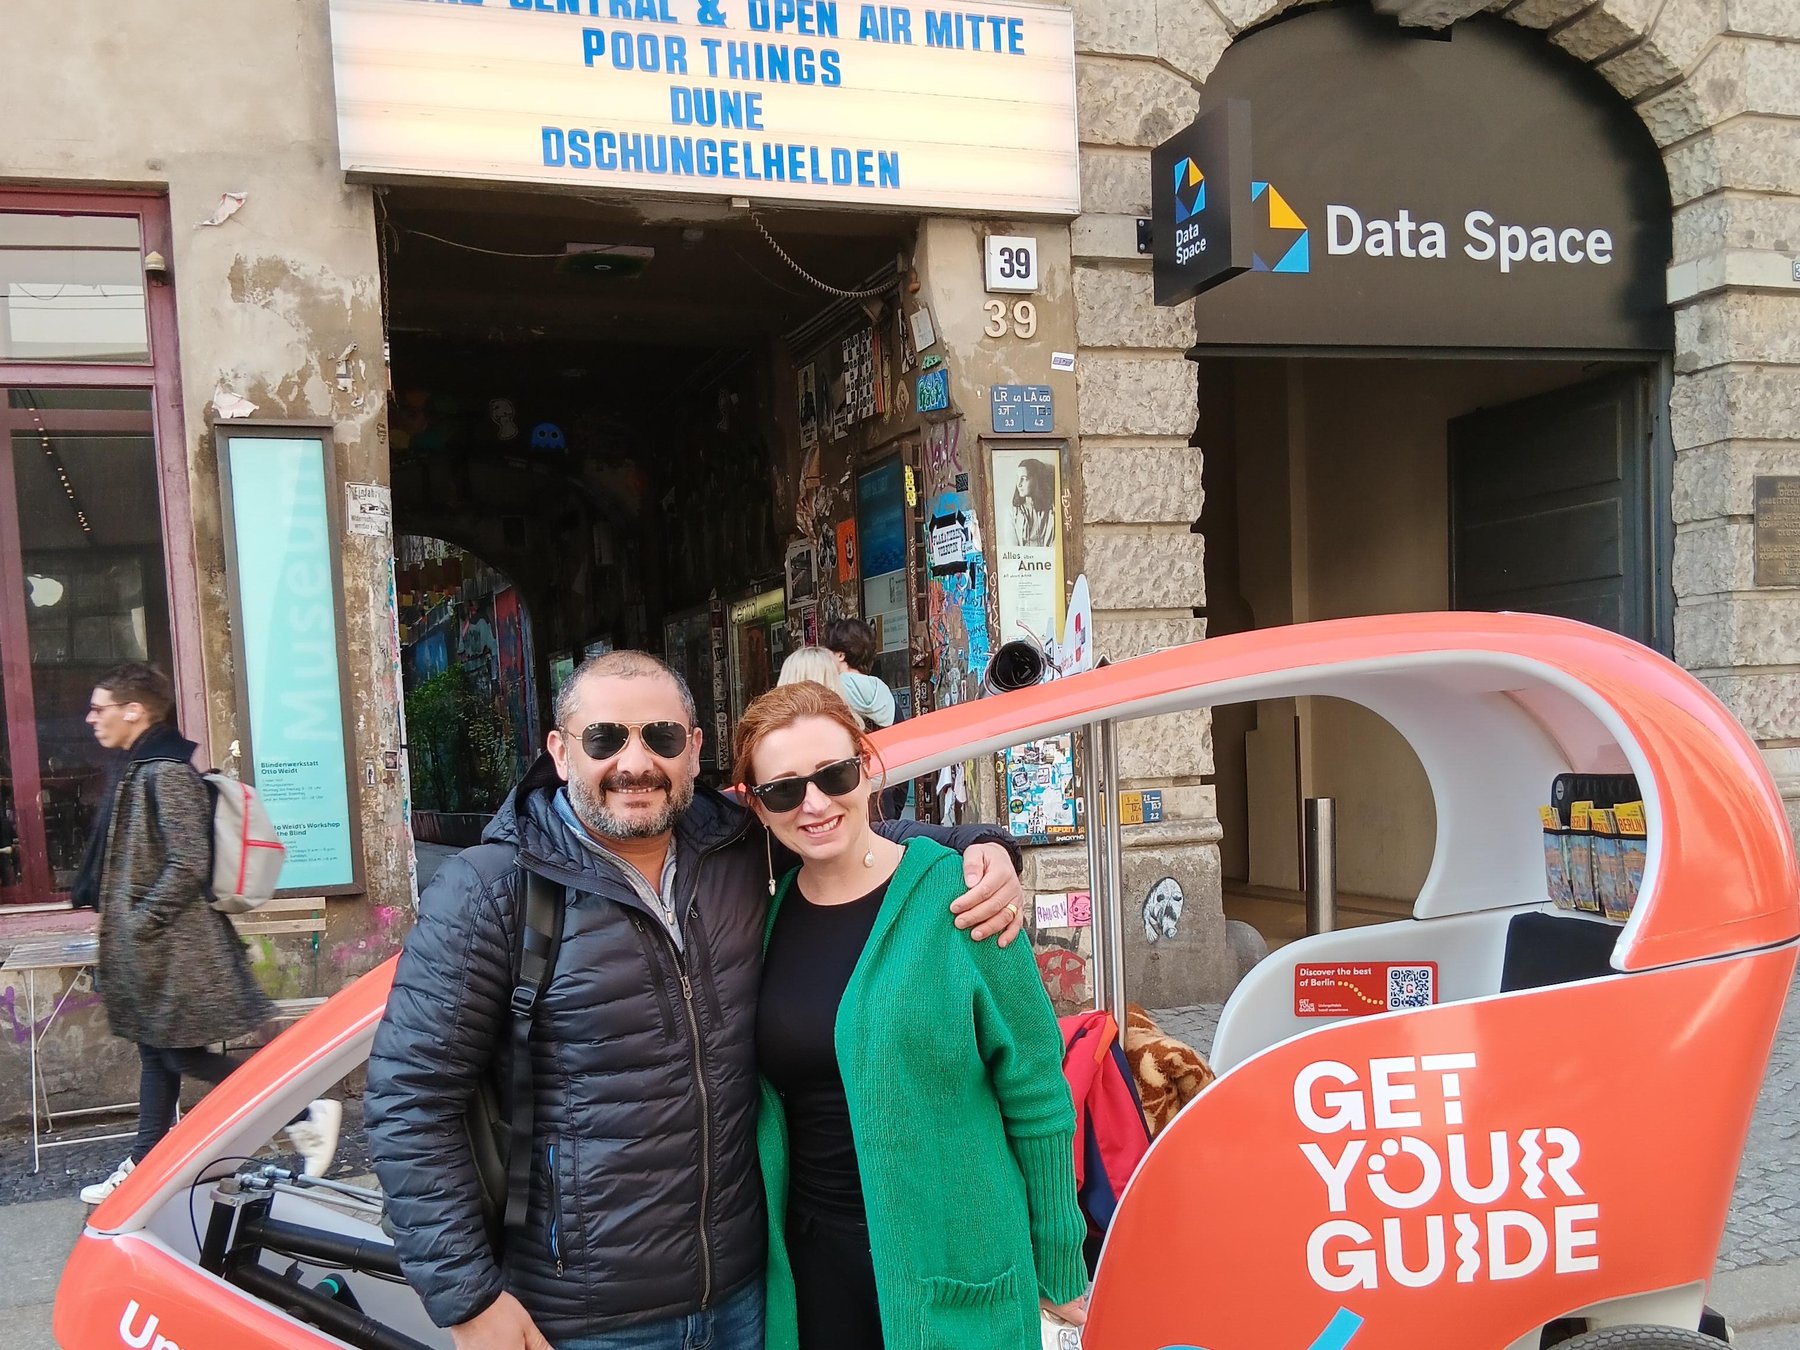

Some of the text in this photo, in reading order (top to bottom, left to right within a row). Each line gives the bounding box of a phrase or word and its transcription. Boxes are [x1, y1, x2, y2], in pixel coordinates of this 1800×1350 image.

[697, 0, 727, 28] &
[748, 0, 839, 38] OPEN
[859, 3, 912, 45] AIR
[924, 9, 1025, 55] MITTE
[582, 27, 842, 88] POOR THINGS
[670, 85, 765, 131] DUNE
[541, 126, 900, 189] DSCHUNGELHELDEN
[1176, 223, 1199, 247] Data
[1176, 238, 1207, 265] Space
[1326, 204, 1614, 273] Data Space
[999, 247, 1031, 279] 39
[984, 299, 1037, 339] 39
[993, 391, 1008, 402] LR
[1023, 391, 1037, 402] LA
[1002, 552, 1021, 560] Alles
[1018, 560, 1052, 571] Anne
[280, 447, 338, 743] Museum
[1618, 818, 1644, 832] BERLIN
[1299, 978, 1335, 986] of Berlin
[1300, 967, 1372, 976] Discover the best
[1293, 1052, 1477, 1134] GET
[1298, 1127, 1586, 1213] YOUR
[1306, 1203, 1599, 1292] GUIDE
